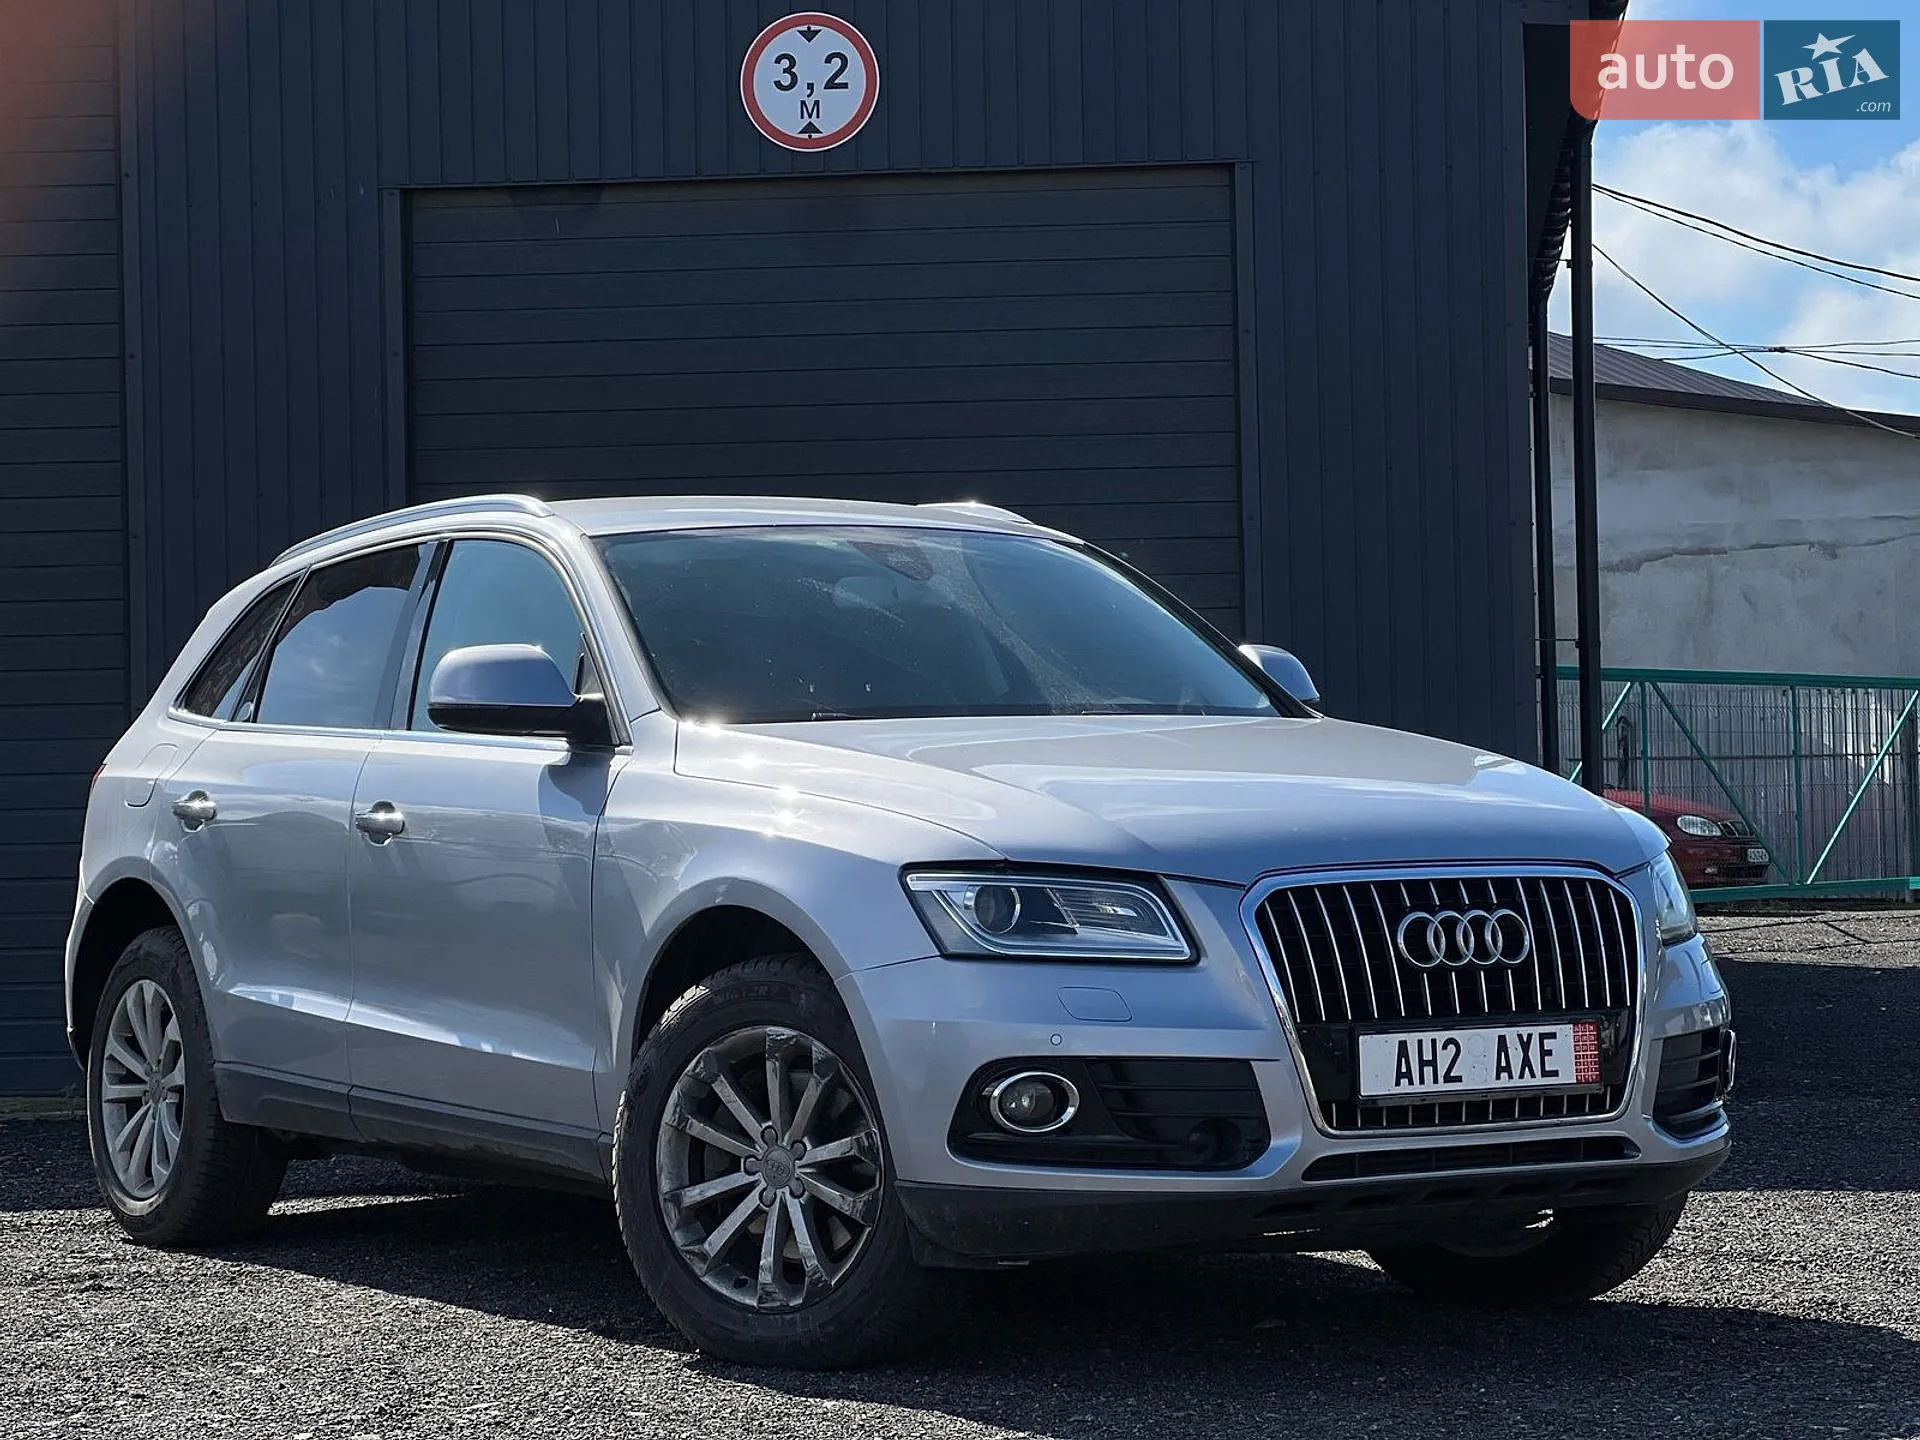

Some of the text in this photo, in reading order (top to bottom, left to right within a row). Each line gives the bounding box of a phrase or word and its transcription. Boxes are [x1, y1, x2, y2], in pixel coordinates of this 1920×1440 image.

[773, 52, 849, 98] 3,2
[1394, 1037, 1463, 1087] AH2
[1495, 1032, 1559, 1081] AXE
